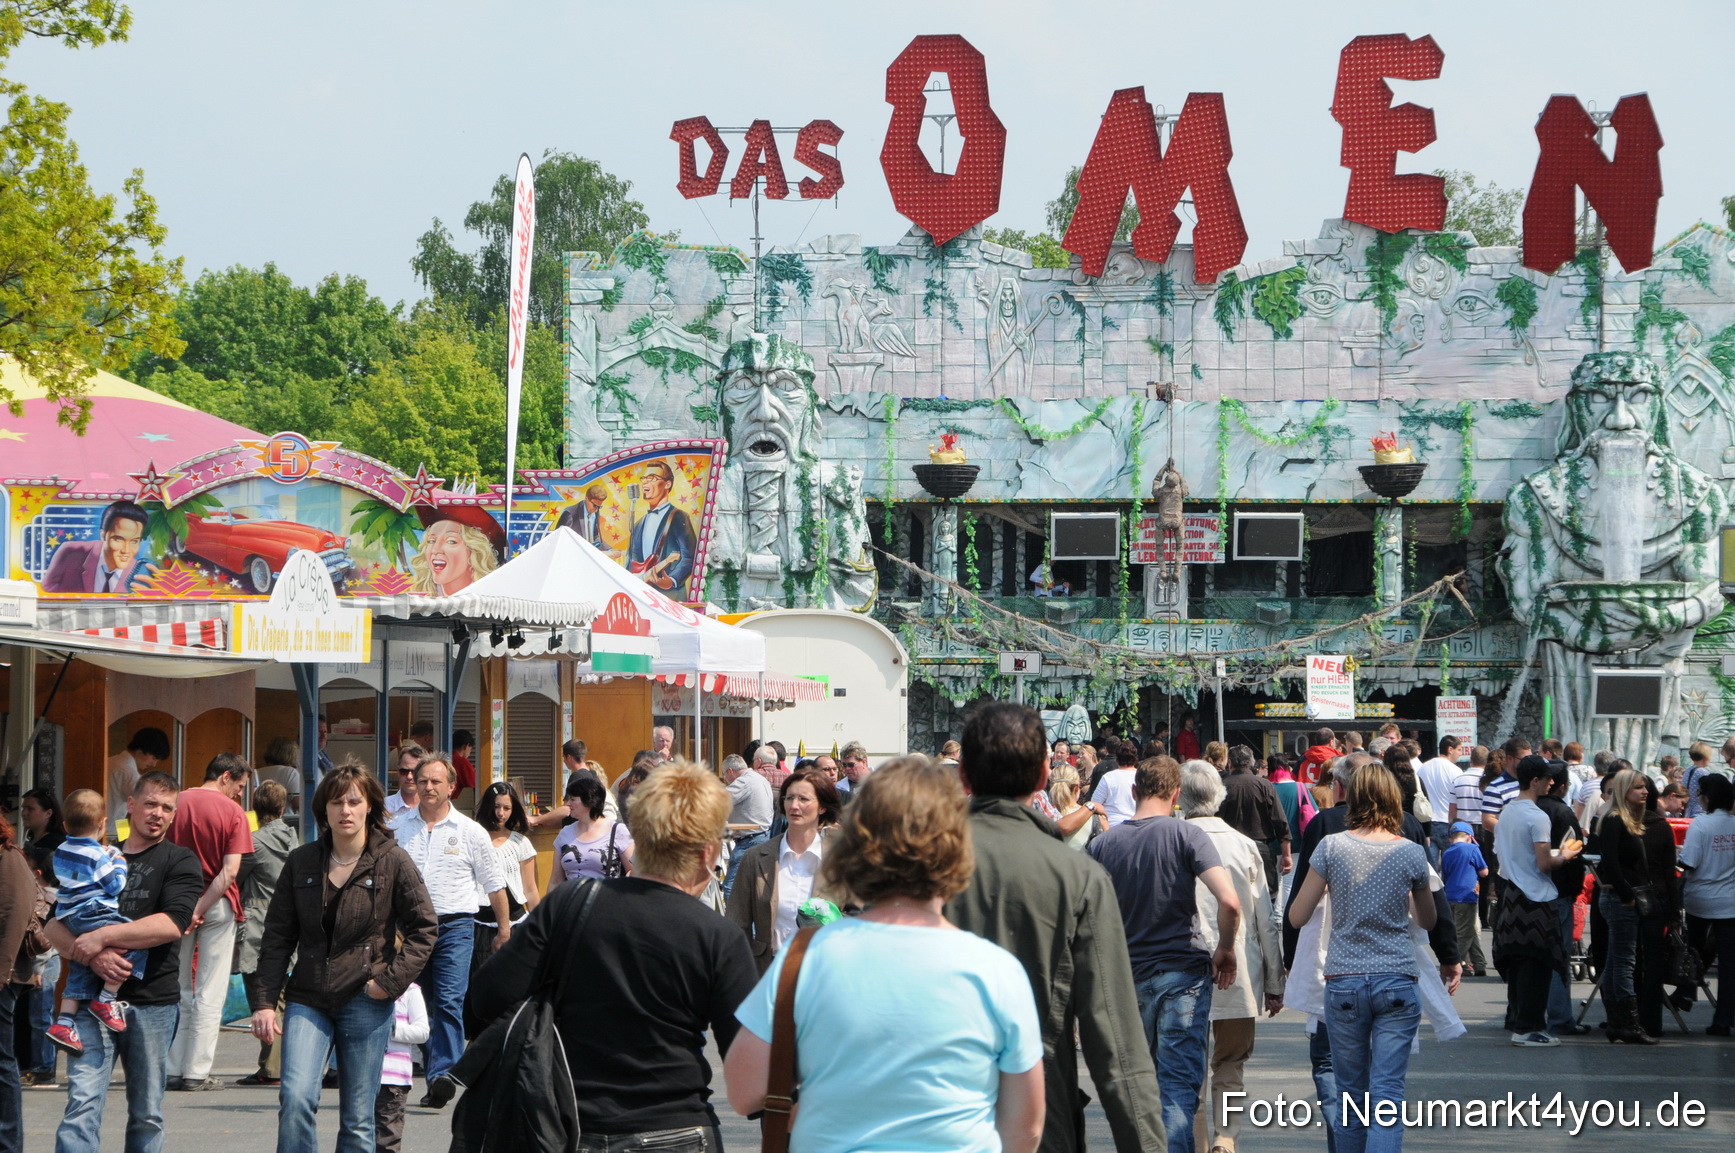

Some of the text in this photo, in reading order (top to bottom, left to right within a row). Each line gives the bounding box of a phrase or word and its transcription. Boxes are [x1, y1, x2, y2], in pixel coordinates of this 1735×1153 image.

[669, 33, 1664, 284] DAS OMEN
[270, 440, 309, 477] ED
[1184, 517, 1222, 533] CHTUNG!
[1208, 542, 1220, 551] SIE
[283, 554, 329, 615] La Crêpe
[606, 596, 639, 632] LANGOS
[248, 614, 259, 651] Die
[294, 618, 303, 651] die
[306, 629, 313, 651] zu
[315, 617, 331, 652] Ihnen
[405, 646, 425, 676] LANG
[1312, 657, 1347, 675] NEU
[1310, 674, 1351, 684] nur HIER
[1310, 695, 1351, 710] Geistermaske
